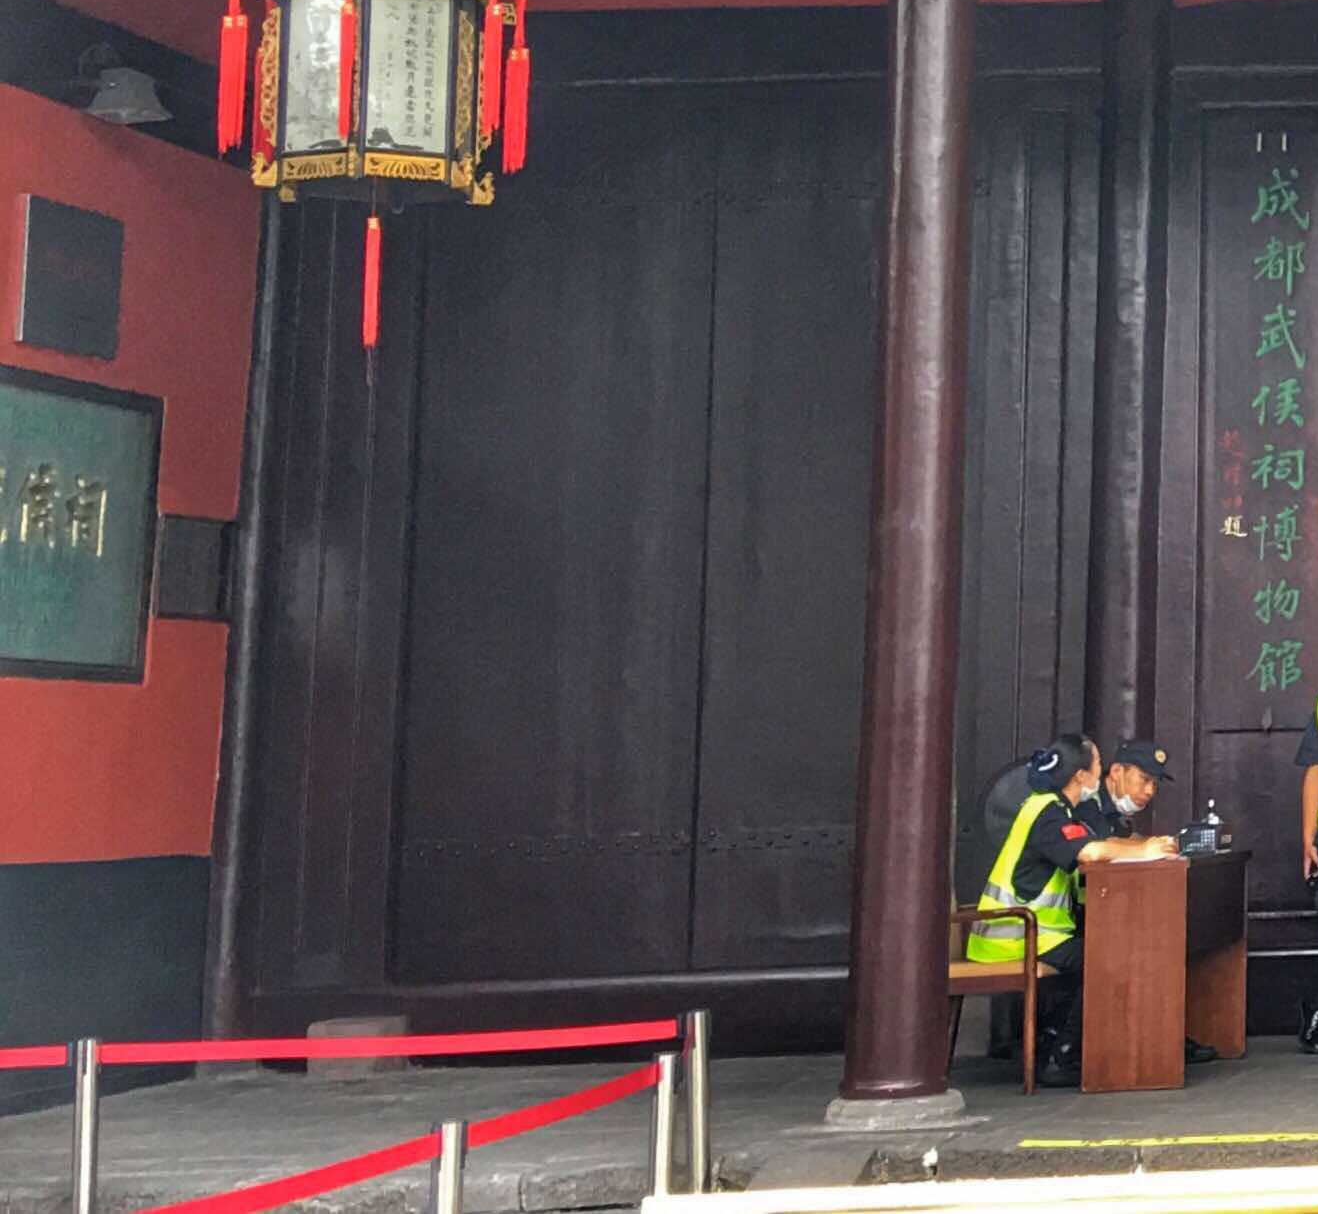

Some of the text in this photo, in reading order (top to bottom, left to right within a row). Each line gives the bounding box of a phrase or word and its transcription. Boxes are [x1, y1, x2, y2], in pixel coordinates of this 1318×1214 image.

[1246, 167, 1309, 692] 成都武侯祠博物館
